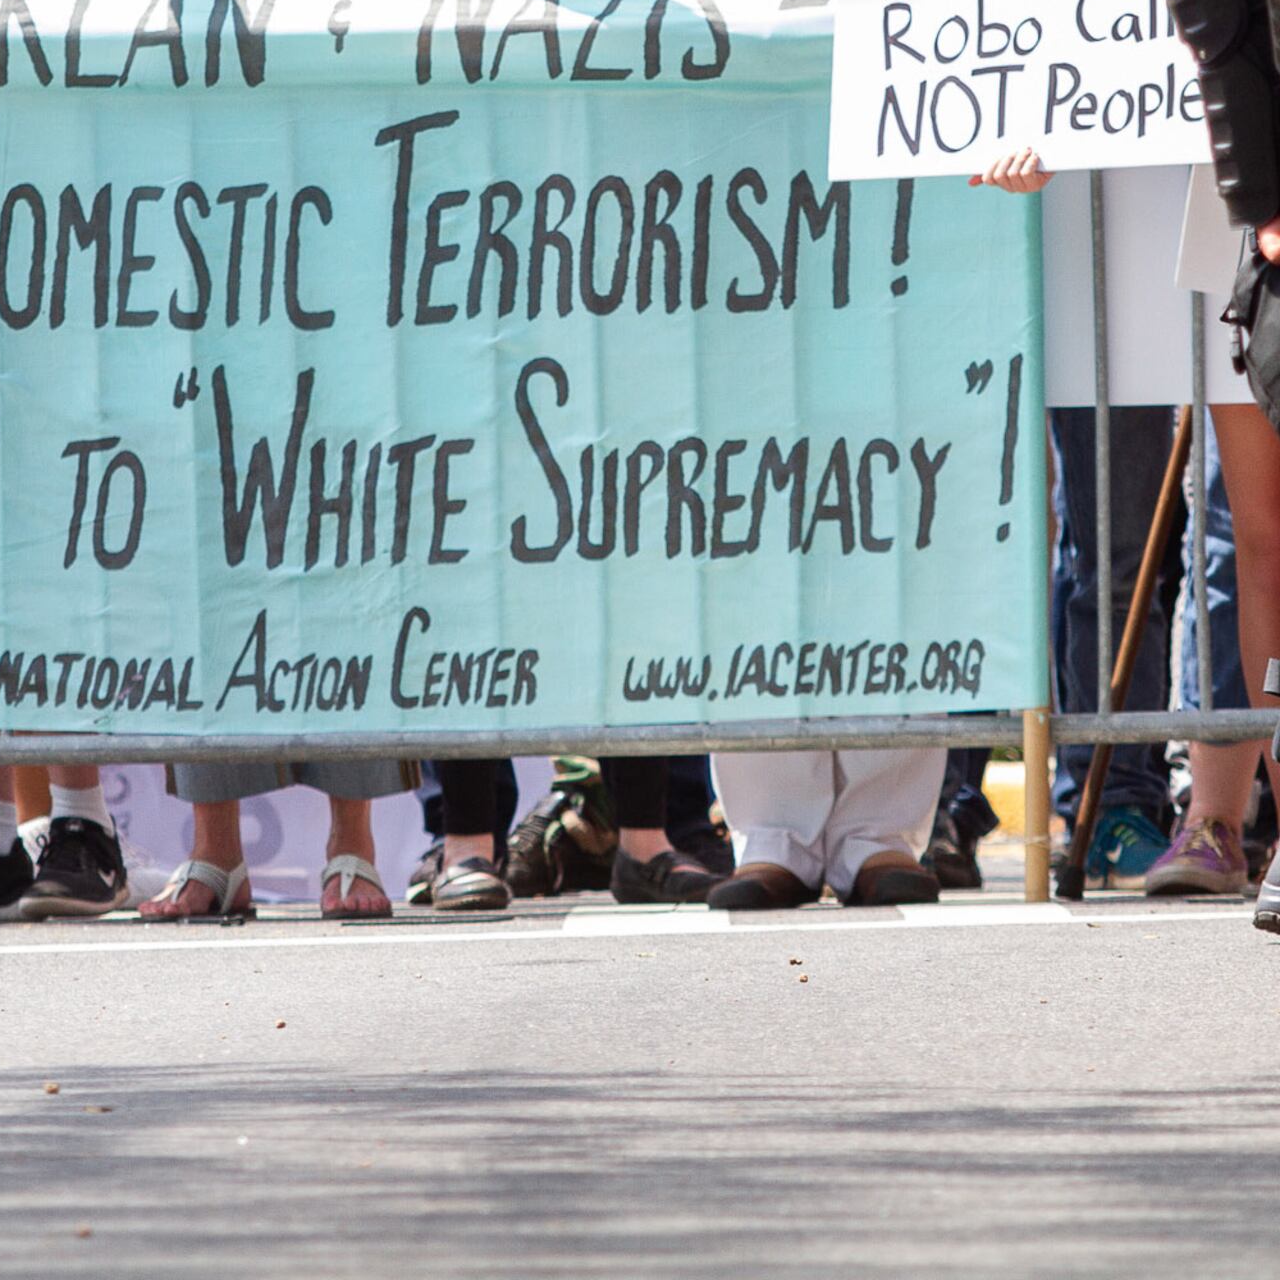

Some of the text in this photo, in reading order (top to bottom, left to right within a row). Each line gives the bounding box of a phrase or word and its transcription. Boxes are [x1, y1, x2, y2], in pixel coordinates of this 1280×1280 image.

[877, 62, 1207, 158] NOT People
[61, 436, 147, 571] TO
[215, 608, 375, 713] ACTION
[390, 605, 539, 711] CENTER
